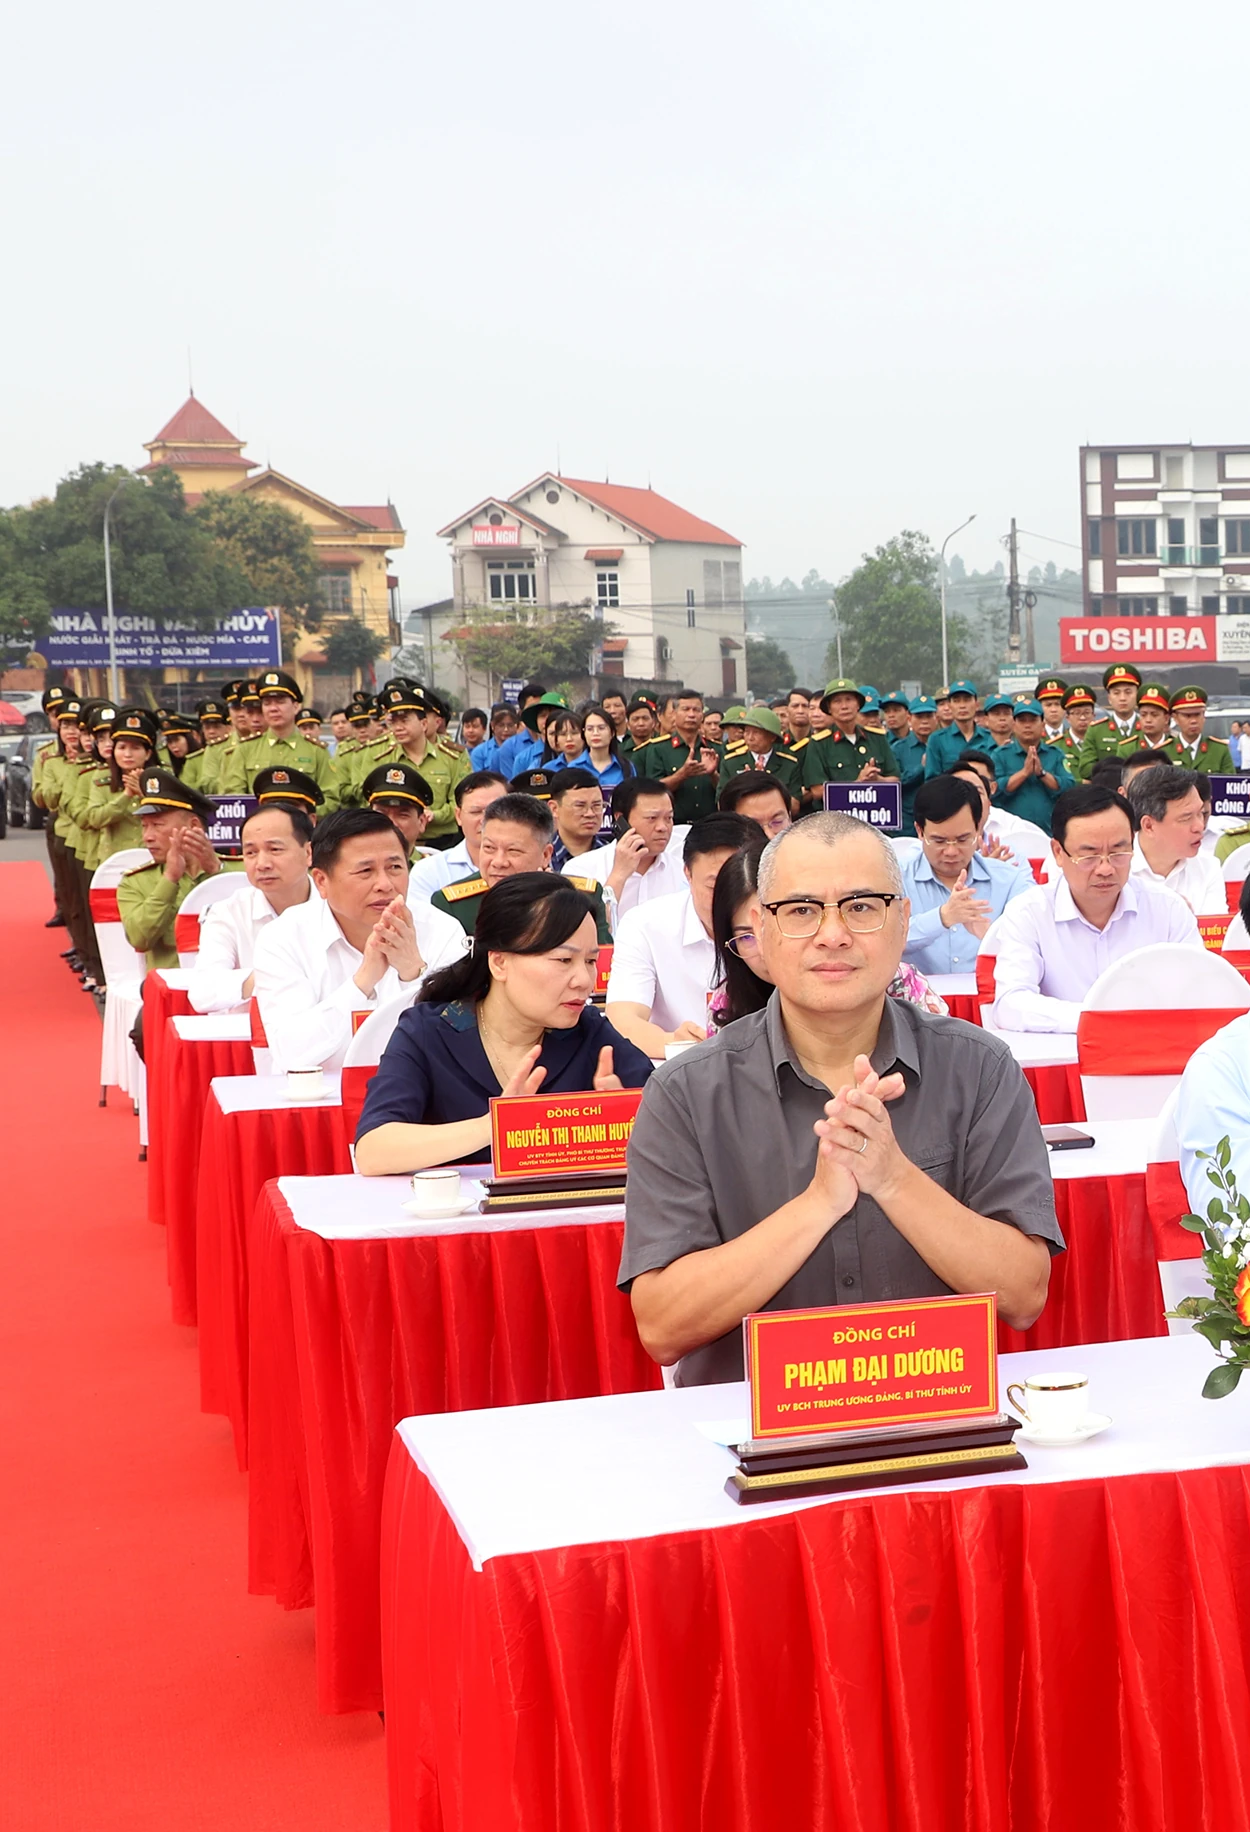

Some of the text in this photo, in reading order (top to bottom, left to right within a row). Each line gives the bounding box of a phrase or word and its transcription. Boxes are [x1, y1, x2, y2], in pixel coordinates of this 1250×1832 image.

[242, 634, 270, 644] CAFE
[1069, 627, 1208, 651] TOSHIBA
[848, 786, 877, 803] KHỐI
[1226, 779, 1250, 795] KHỐI
[216, 800, 246, 818] KHỐI
[1215, 798, 1244, 814] CÔNG
[870, 807, 891, 825] ĐỘI
[205, 821, 233, 840] IỂM
[546, 1104, 602, 1119] ĐỒNG CHÍ
[506, 1116, 635, 1149] NGUYỄN THỊ THANH HUY
[832, 1320, 916, 1345] ĐỒNG CHÍ
[784, 1347, 964, 1392] PHẠM ĐẠI DƯƠNG
[777, 1403, 792, 1413] UV
[792, 1400, 812, 1412] BCH
[813, 1397, 844, 1410] TRUNG
[846, 1394, 874, 1406] ƯƠNG
[905, 1390, 914, 1400] BÍ
[916, 1388, 936, 1398] THƯ
[936, 1384, 958, 1396] TỈNH
[959, 1383, 972, 1394] ỦY
